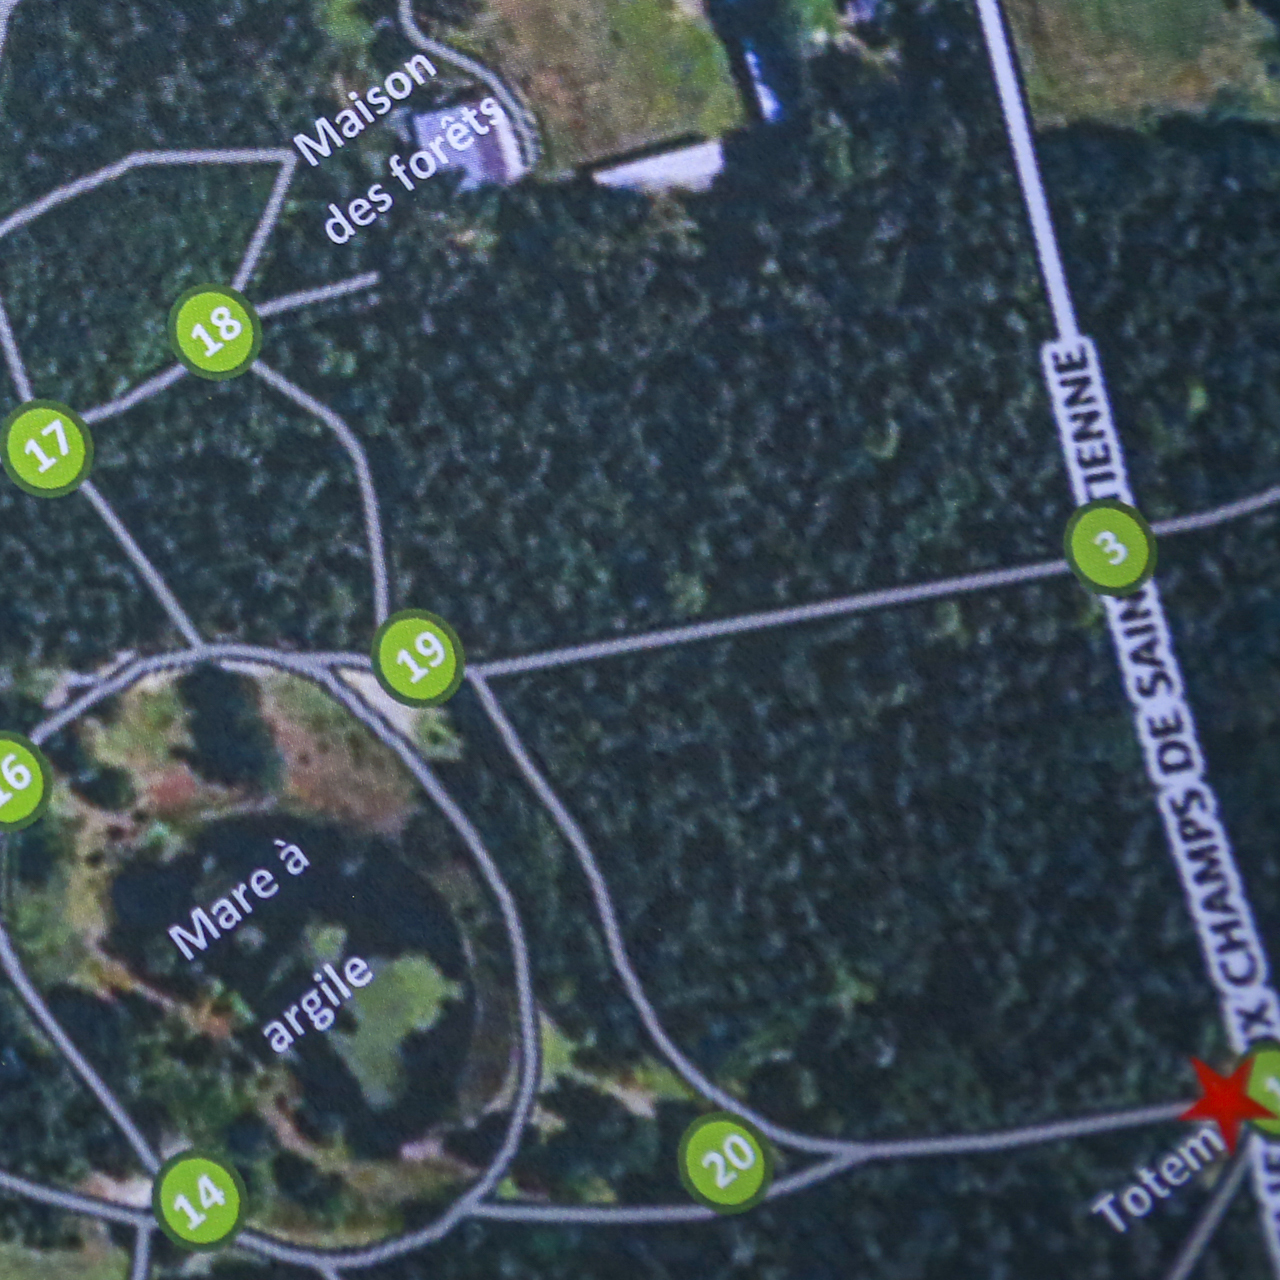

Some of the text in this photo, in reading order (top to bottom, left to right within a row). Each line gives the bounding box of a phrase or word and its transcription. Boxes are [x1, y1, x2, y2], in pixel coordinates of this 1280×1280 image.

[292, 53, 438, 167] Maison
[323, 96, 504, 245] des forêts
[189, 305, 243, 359] 18
[22, 419, 71, 474] 17
[1093, 529, 1129, 566] 3
[395, 630, 446, 685] 19
[1116, 591, 1173, 702] SAIN
[1148, 709, 1196, 776] DE
[166, 838, 311, 962] Mare à
[1168, 789, 1258, 987] CHAMPS
[260, 951, 374, 1054] argile
[172, 1173, 227, 1231] 14
[700, 1133, 756, 1190] 20
[1091, 1127, 1226, 1233] Totem
